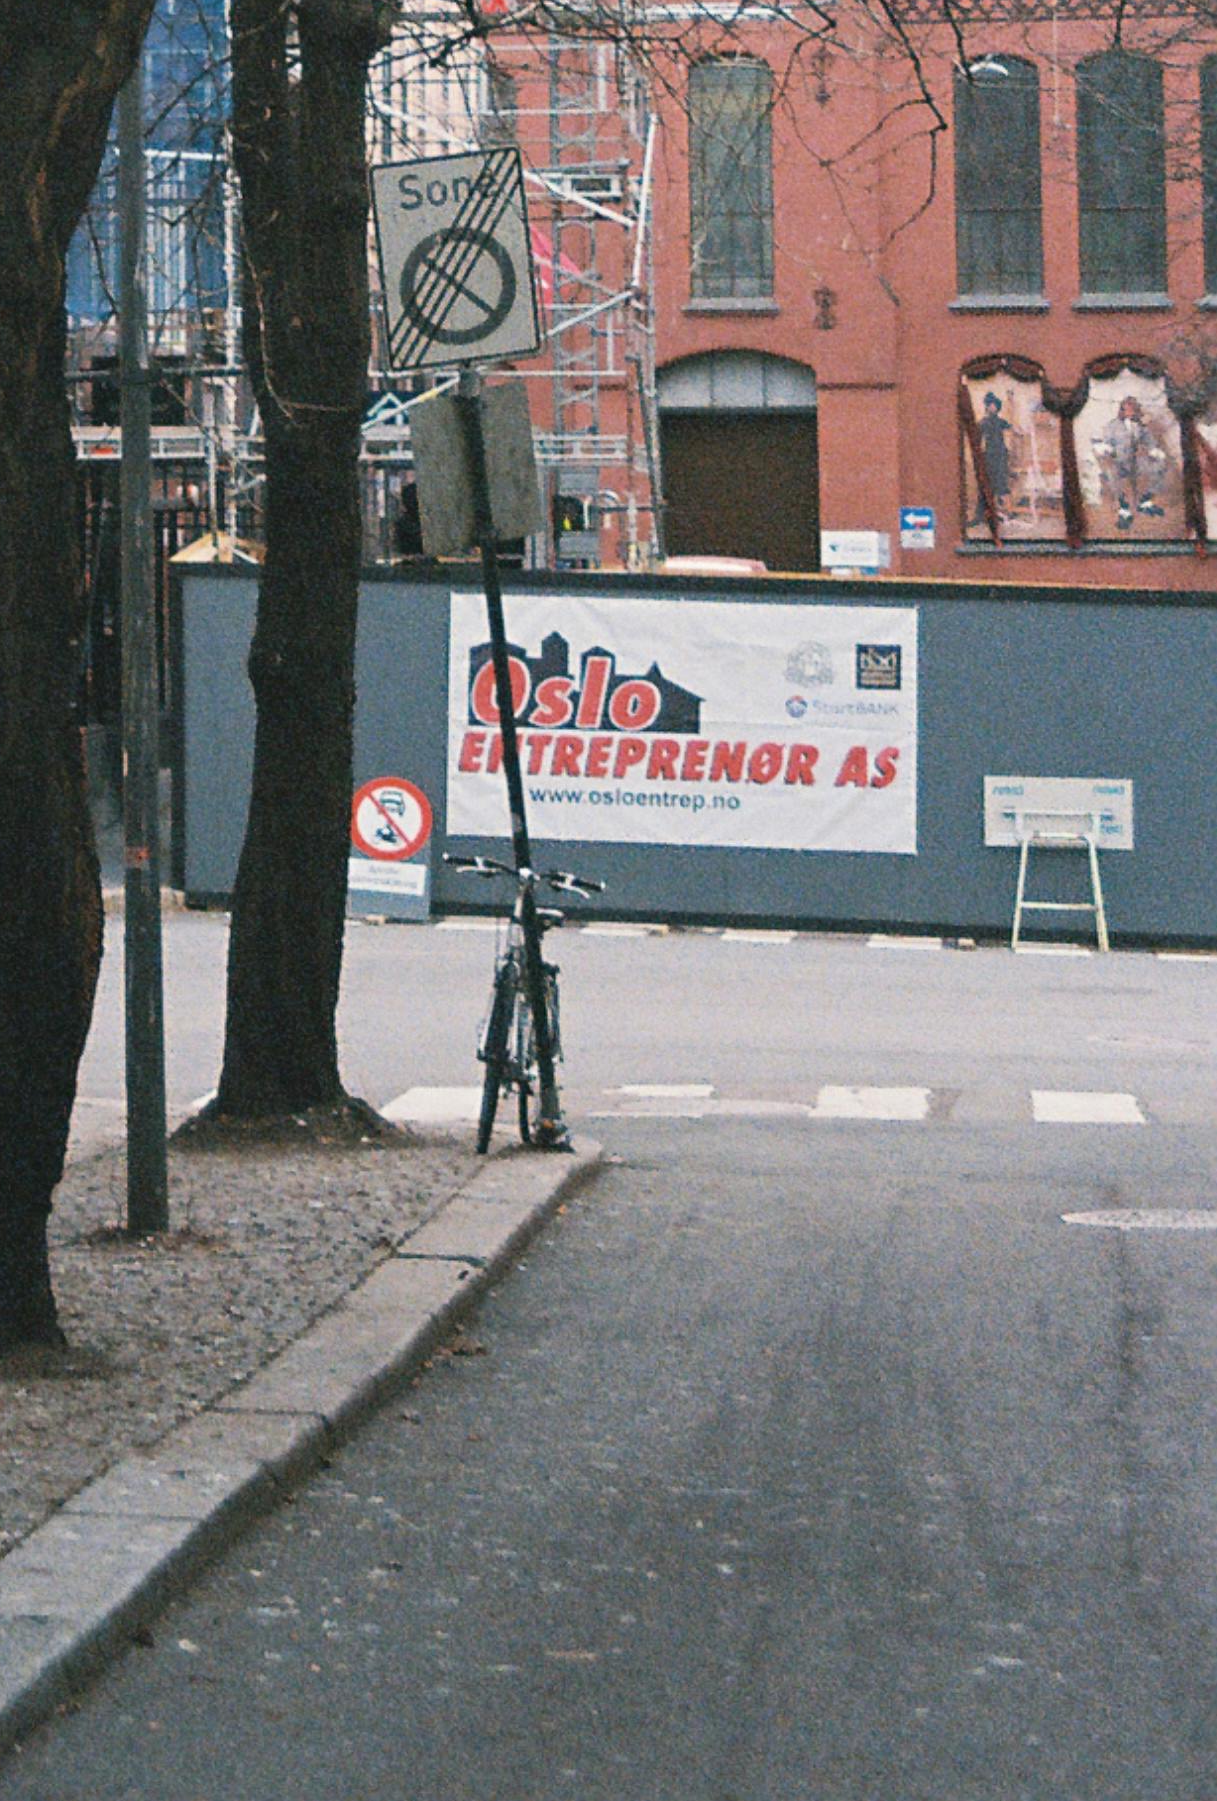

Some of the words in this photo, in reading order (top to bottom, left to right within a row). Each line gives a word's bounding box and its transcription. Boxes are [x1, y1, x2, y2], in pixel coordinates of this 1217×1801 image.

[470, 653, 662, 732] Oslo
[833, 745, 902, 790] AS
[528, 785, 742, 813] www.osloentrep.no
